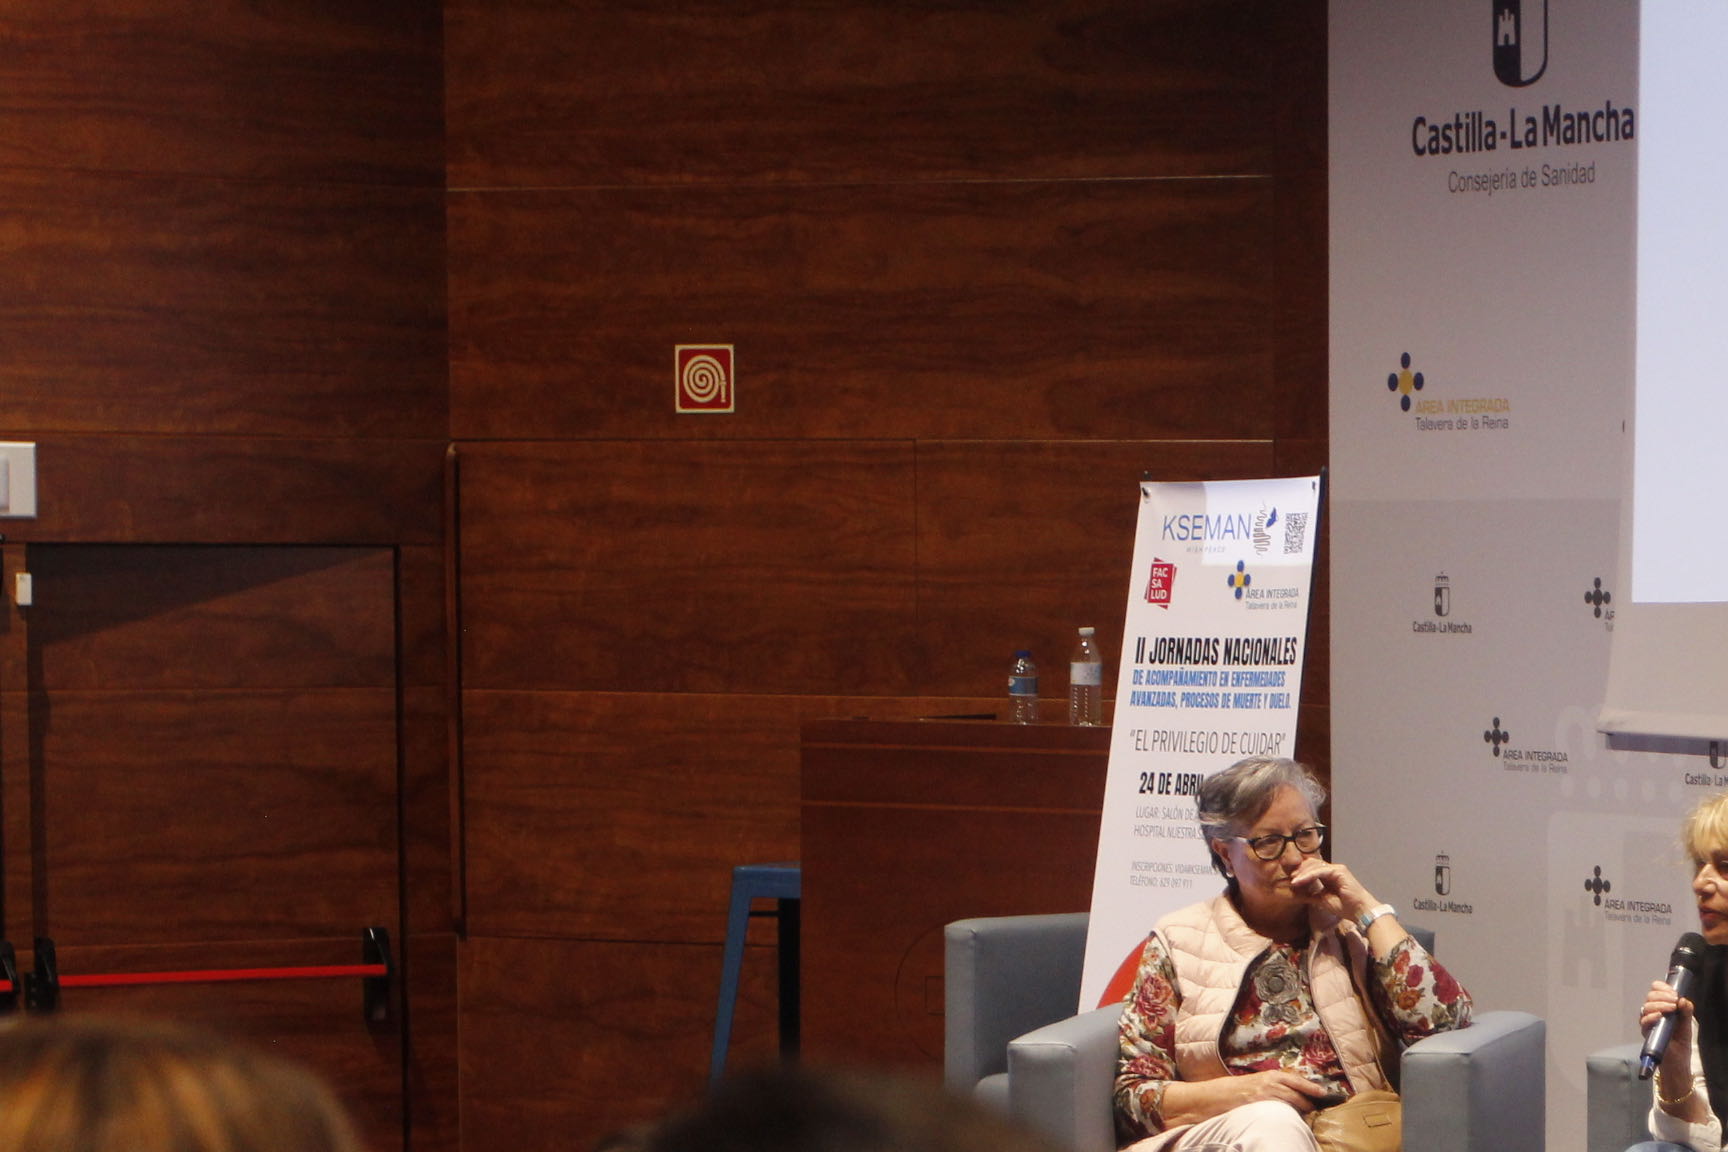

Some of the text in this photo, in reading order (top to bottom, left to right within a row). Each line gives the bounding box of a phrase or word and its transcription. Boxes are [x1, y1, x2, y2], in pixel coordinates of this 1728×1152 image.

[1543, 100, 1635, 146] Mancha
[1521, 165, 1538, 188] de
[1541, 161, 1596, 187] Sanidad
[1447, 398, 1511, 414] INTEGRADA
[1416, 415, 1509, 431] Talavera de la Reina
[1162, 514, 1251, 541] KSEMAN
[1152, 567, 1168, 578] FAC
[1151, 578, 1162, 589] SA
[1150, 589, 1167, 600] LUD
[1266, 587, 1299, 599] INTEGRADA
[1448, 622, 1472, 633] Mancha
[1135, 636, 1298, 666] II JORNADAS NACIONALES
[1132, 667, 1286, 687] DE ACOMPAÑAMIENTO EN ENFERMEDADES
[1130, 690, 1178, 709] AVANZADAS,
[1180, 692, 1219, 708] PROCESOS
[1221, 693, 1231, 708] DE
[1232, 693, 1262, 709] MUERTE
[1151, 730, 1218, 754] PRIVILEGIO
[1221, 732, 1237, 754] DE
[1525, 751, 1568, 762] INTEGRADA
[1139, 772, 1155, 794] 24
[1157, 773, 1172, 795] DE
[1133, 824, 1166, 838] HOSPITAL
[1167, 826, 1196, 839] NUESTRA
[1448, 900, 1473, 914] Mancha
[1627, 900, 1672, 914] INTEGRADA
